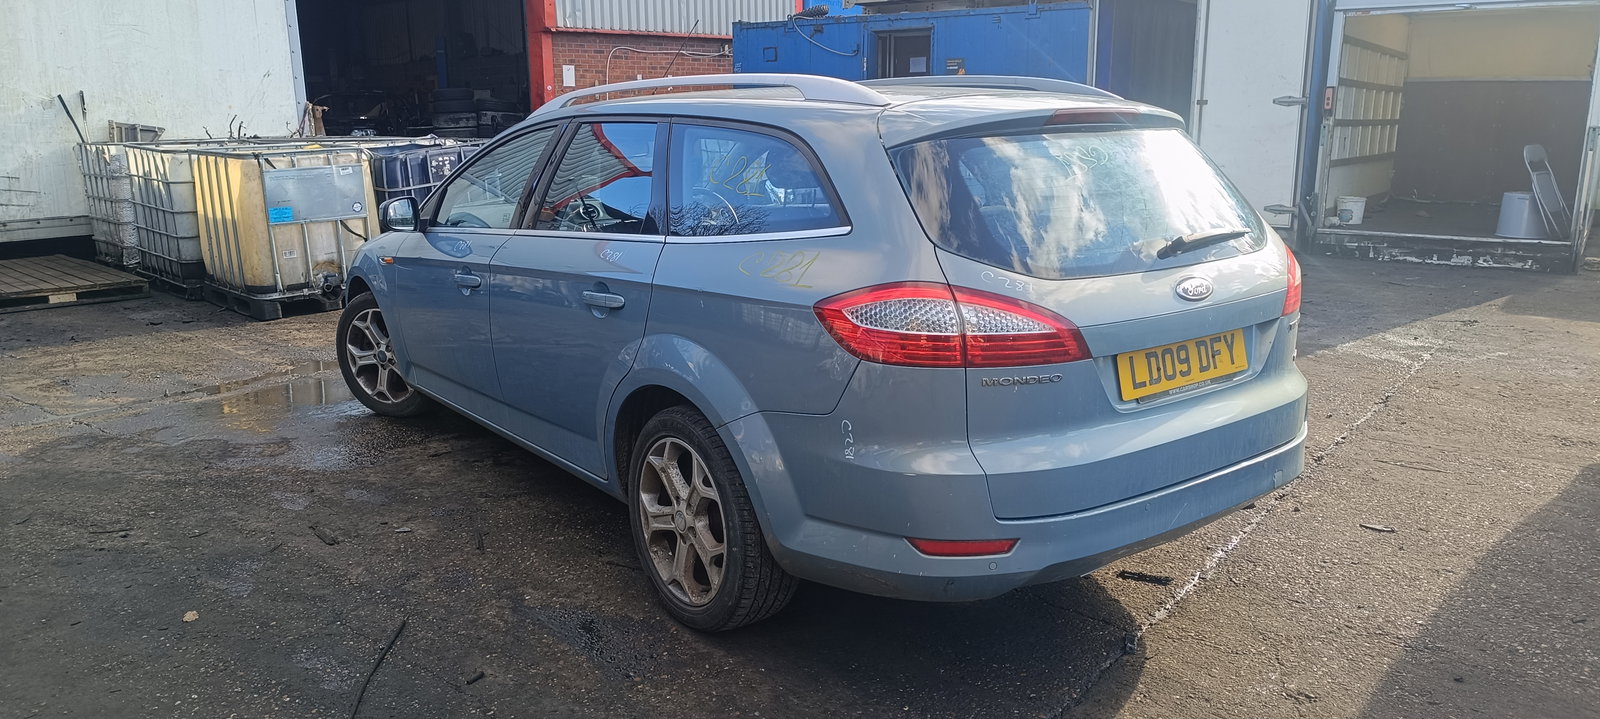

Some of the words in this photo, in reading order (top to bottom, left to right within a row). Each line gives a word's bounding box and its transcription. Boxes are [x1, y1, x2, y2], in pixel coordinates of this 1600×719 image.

[1128, 344, 1192, 390] LD09
[1195, 333, 1235, 373] DFY
[981, 373, 1063, 387] MONDEO
